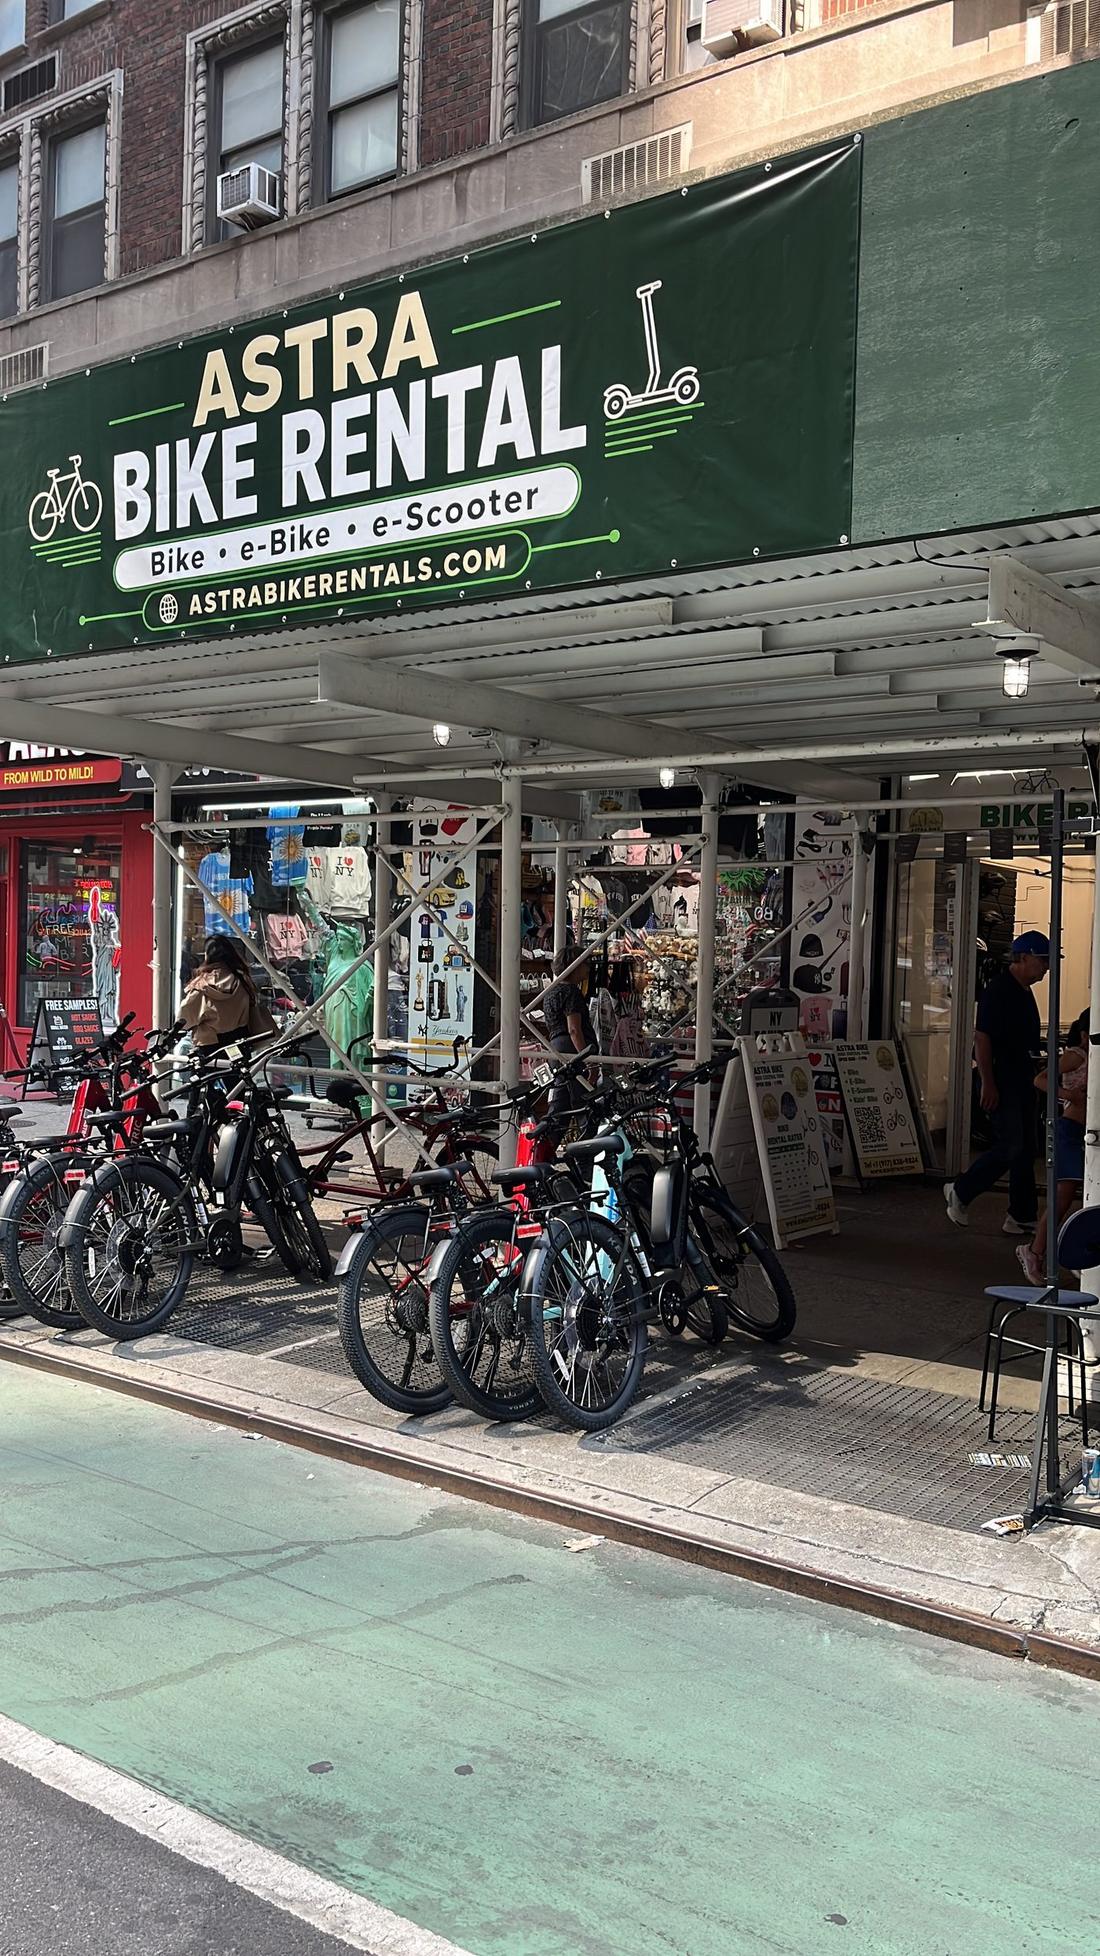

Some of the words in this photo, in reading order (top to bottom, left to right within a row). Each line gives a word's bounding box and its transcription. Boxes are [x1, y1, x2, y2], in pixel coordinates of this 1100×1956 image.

[192, 291, 438, 428] ASTRA
[114, 421, 258, 541] BIKE
[282, 345, 587, 508] RENTAL
[151, 546, 205, 576] Bike
[240, 525, 331, 562] e-Bike
[372, 484, 539, 539] e-Scooter
[188, 544, 507, 616] ASTRABIKERENTALS.COM
[4, 772, 29, 784] FROM
[31, 770, 52, 782] WILD
[54, 768, 67, 780] TO
[69, 766, 93, 779] MILD!
[980, 803, 1054, 827] BIKE
[335, 866, 354, 876] NY
[45, 1000, 64, 1011] FREE
[64, 999, 98, 1010] SAMPLES!
[769, 1011, 783, 1026] NY
[753, 1066, 771, 1075] ASTRA
